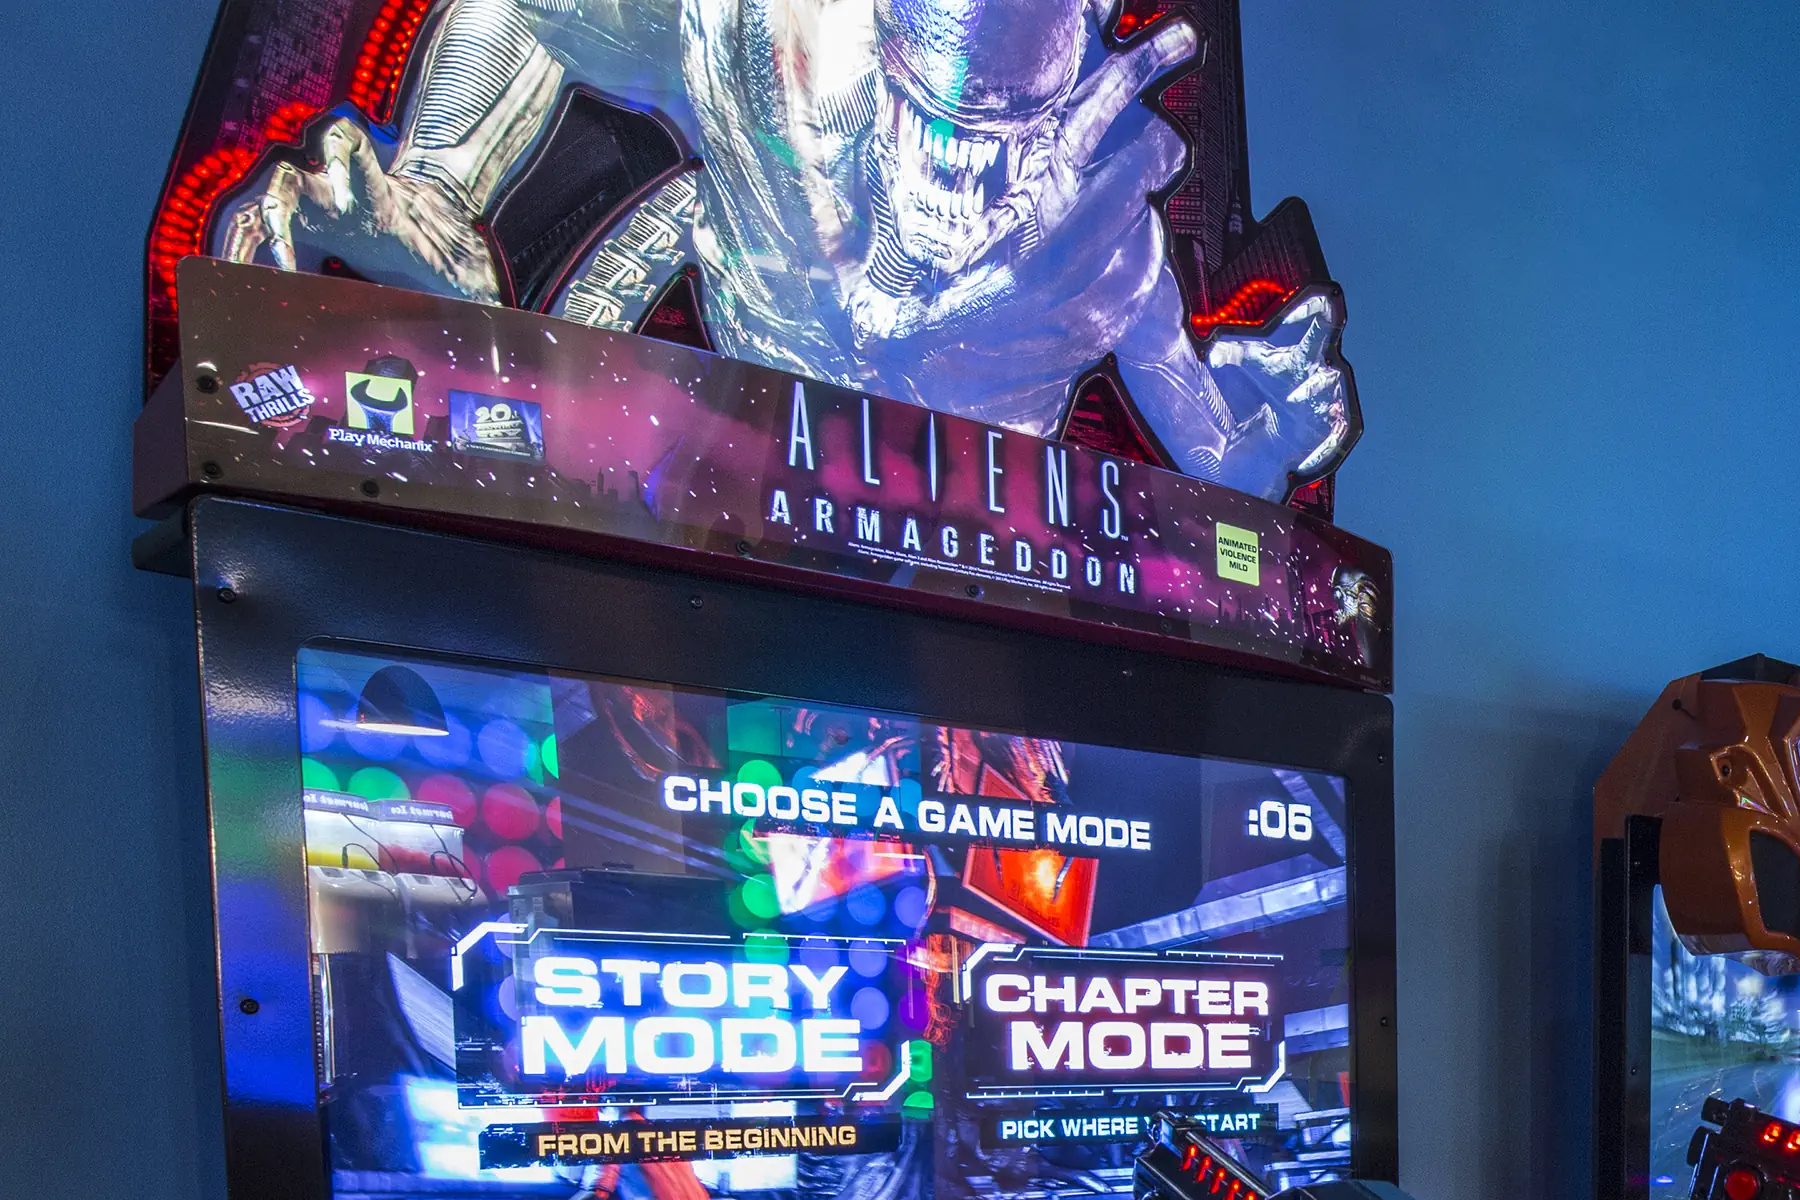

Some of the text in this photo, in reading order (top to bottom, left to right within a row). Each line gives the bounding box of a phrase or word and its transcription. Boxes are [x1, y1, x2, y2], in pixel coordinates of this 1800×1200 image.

[229, 365, 305, 408] RAW
[244, 388, 315, 422] THRILLS
[328, 428, 433, 452] Play Mechanix
[788, 381, 1121, 538] ALIENS
[771, 490, 1136, 594] ARMAGEDDON
[1218, 536, 1257, 553] ANIMATED
[1220, 548, 1256, 564] VIOLENCE
[1229, 561, 1248, 572] MILD
[664, 776, 1152, 851] CHOOSE A GAME MODE
[1248, 799, 1313, 842] :06
[534, 956, 849, 1010] STORY
[985, 972, 1269, 1016] CHAPTER
[521, 1016, 863, 1075] MODE
[1011, 1021, 1251, 1070] MODE
[537, 1125, 857, 1157] FROM THE BEGINNING
[1001, 1119, 1052, 1140] PICK
[1061, 1116, 1139, 1138] WHERE
